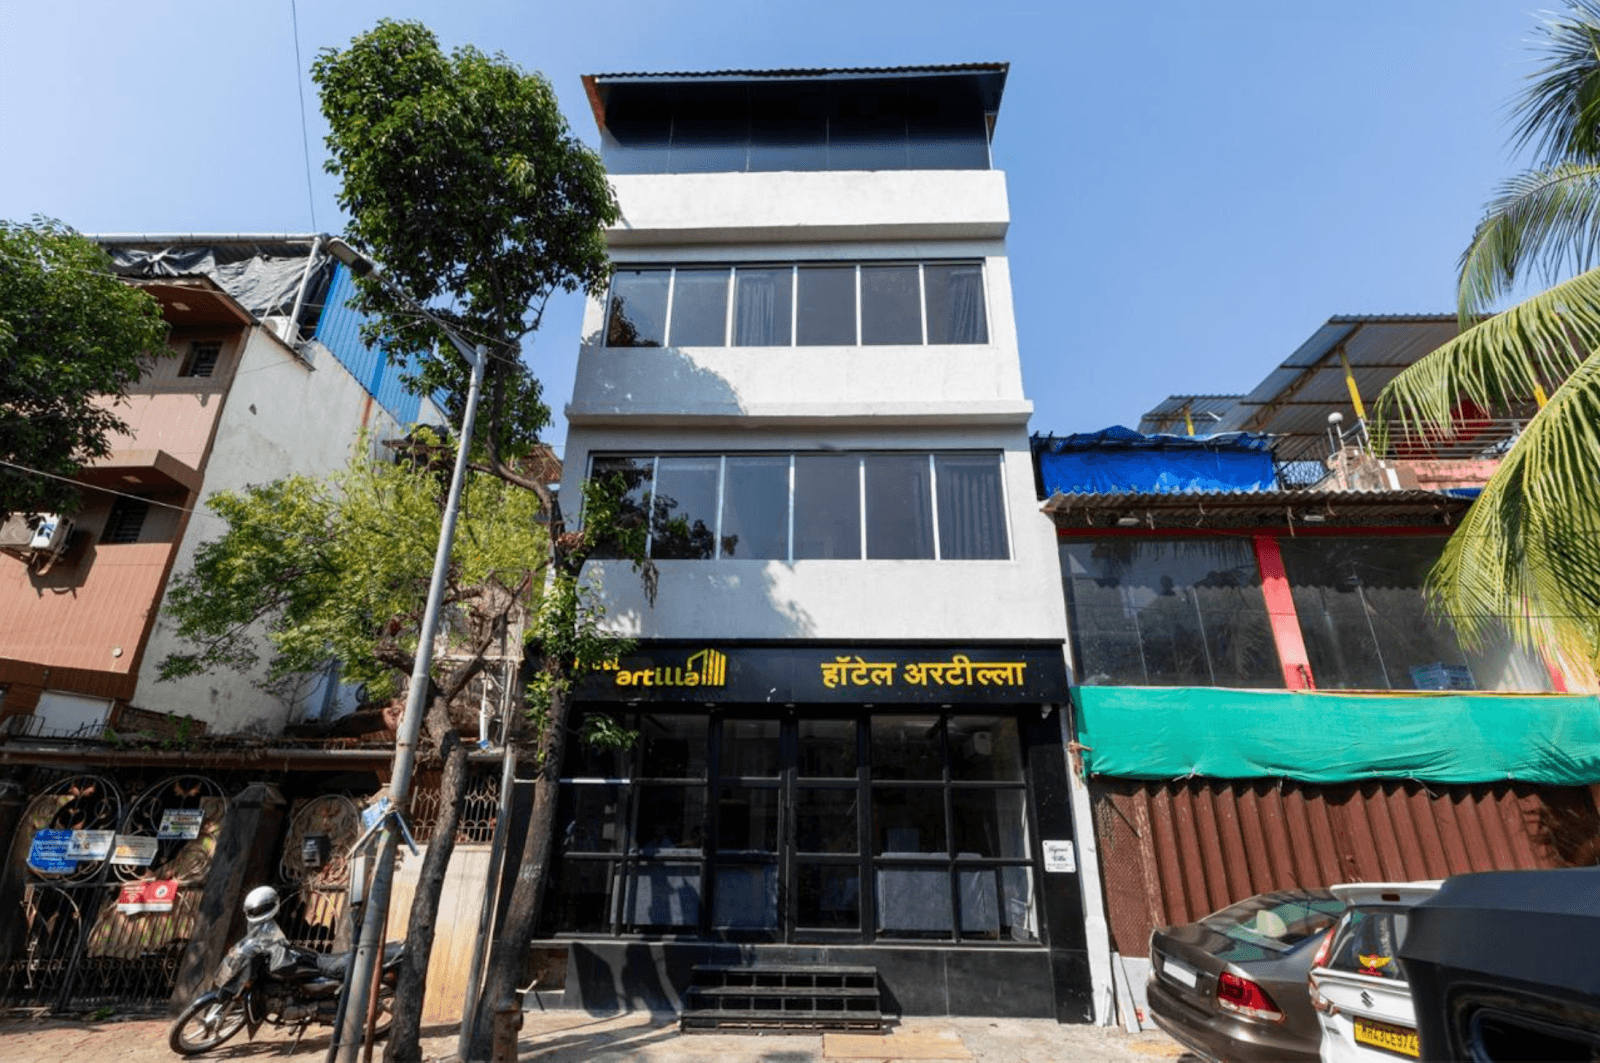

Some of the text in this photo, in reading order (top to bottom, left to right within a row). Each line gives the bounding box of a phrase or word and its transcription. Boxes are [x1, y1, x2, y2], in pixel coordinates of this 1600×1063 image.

[615, 666, 700, 686] artilla
[820, 654, 1027, 688] हॉटेल अरटील्ला
